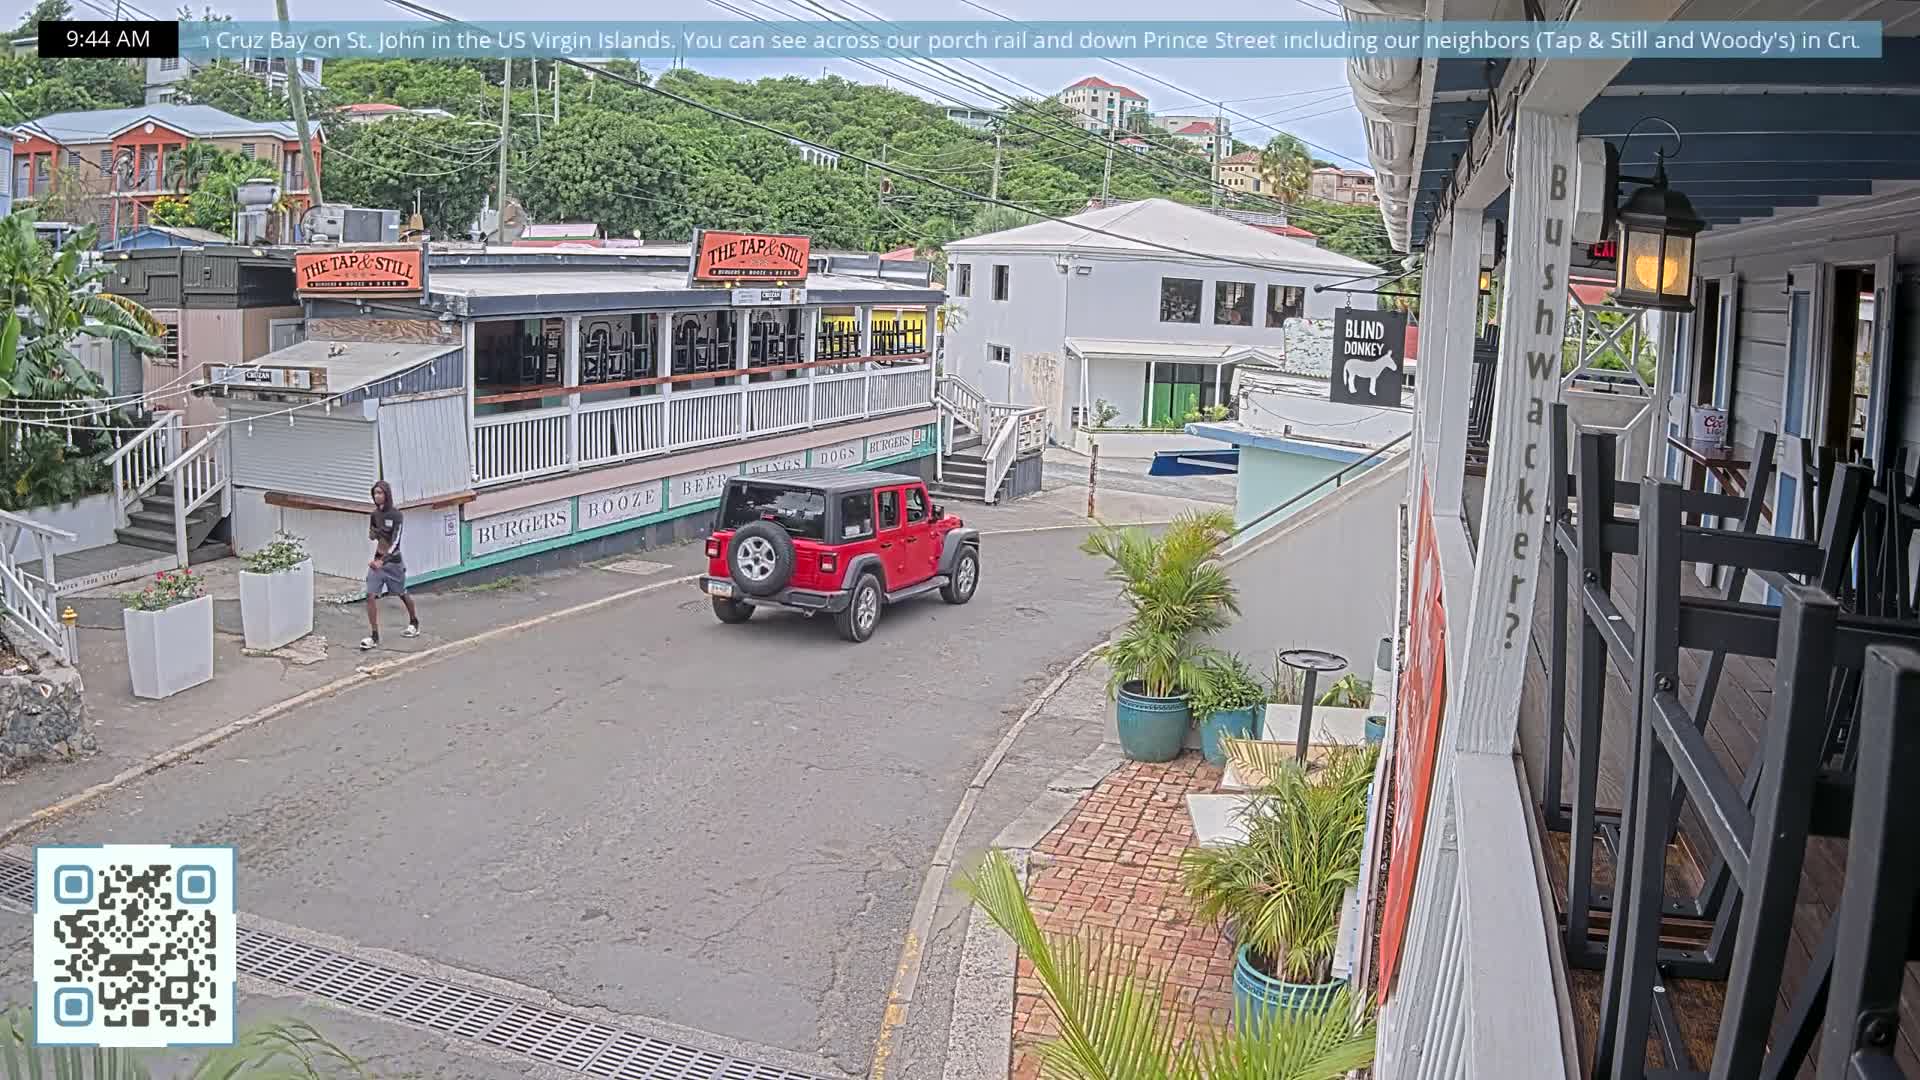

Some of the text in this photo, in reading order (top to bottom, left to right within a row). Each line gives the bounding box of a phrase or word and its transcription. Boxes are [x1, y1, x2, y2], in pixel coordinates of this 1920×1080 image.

[708, 238, 804, 269] THE TAP & STILL
[1594, 241, 1615, 257] EXI
[302, 253, 414, 281] THE TAP & STILL
[1345, 319, 1385, 340] BLIND
[1344, 340, 1385, 357] DONKEY
[1503, 163, 1568, 651] Bushwacker?
[820, 447, 856, 465] DOGS
[869, 434, 911, 454] BURGERS
[682, 472, 728, 496] BEER
[588, 488, 656, 520] BOOZE
[478, 510, 567, 544] BURGERS
